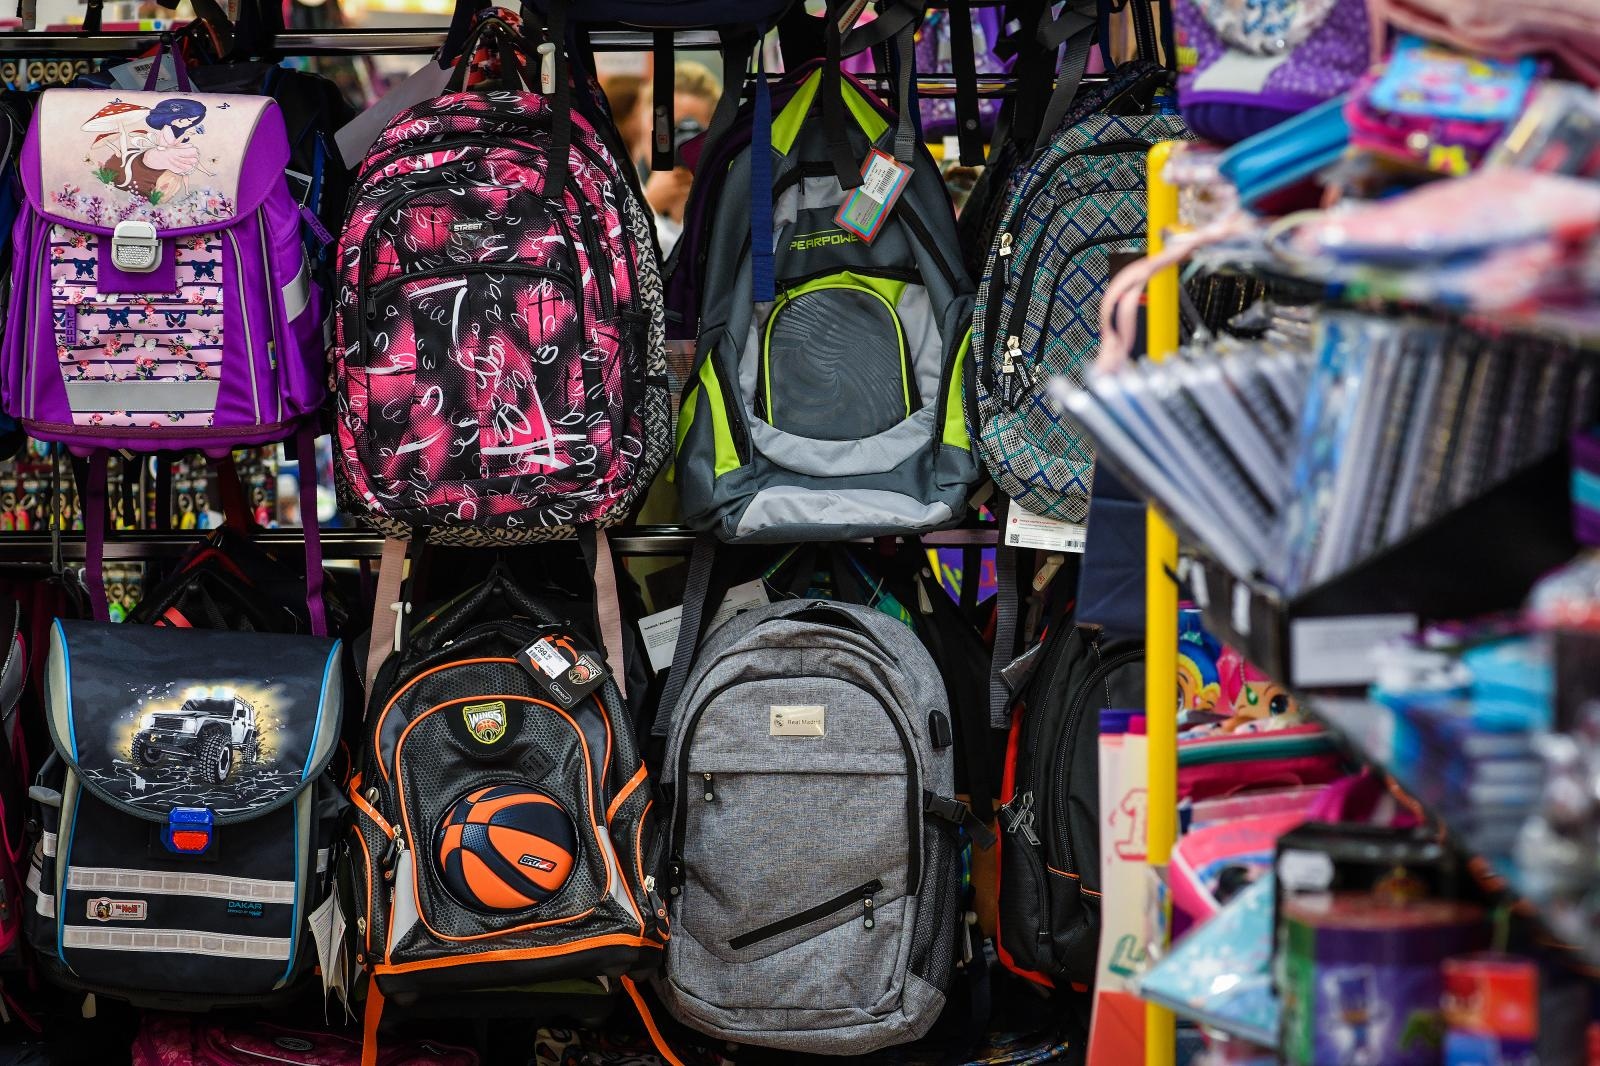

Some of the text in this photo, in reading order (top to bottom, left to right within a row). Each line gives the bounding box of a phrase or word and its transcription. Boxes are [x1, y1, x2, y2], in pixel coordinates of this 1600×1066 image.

[453, 223, 483, 231] STREET
[789, 233, 860, 251] PEARPOWE
[1016, 362, 1031, 388] STREET
[575, 655, 602, 680] WINGS
[467, 709, 503, 730] WINGS
[228, 901, 262, 910] DAKAR
